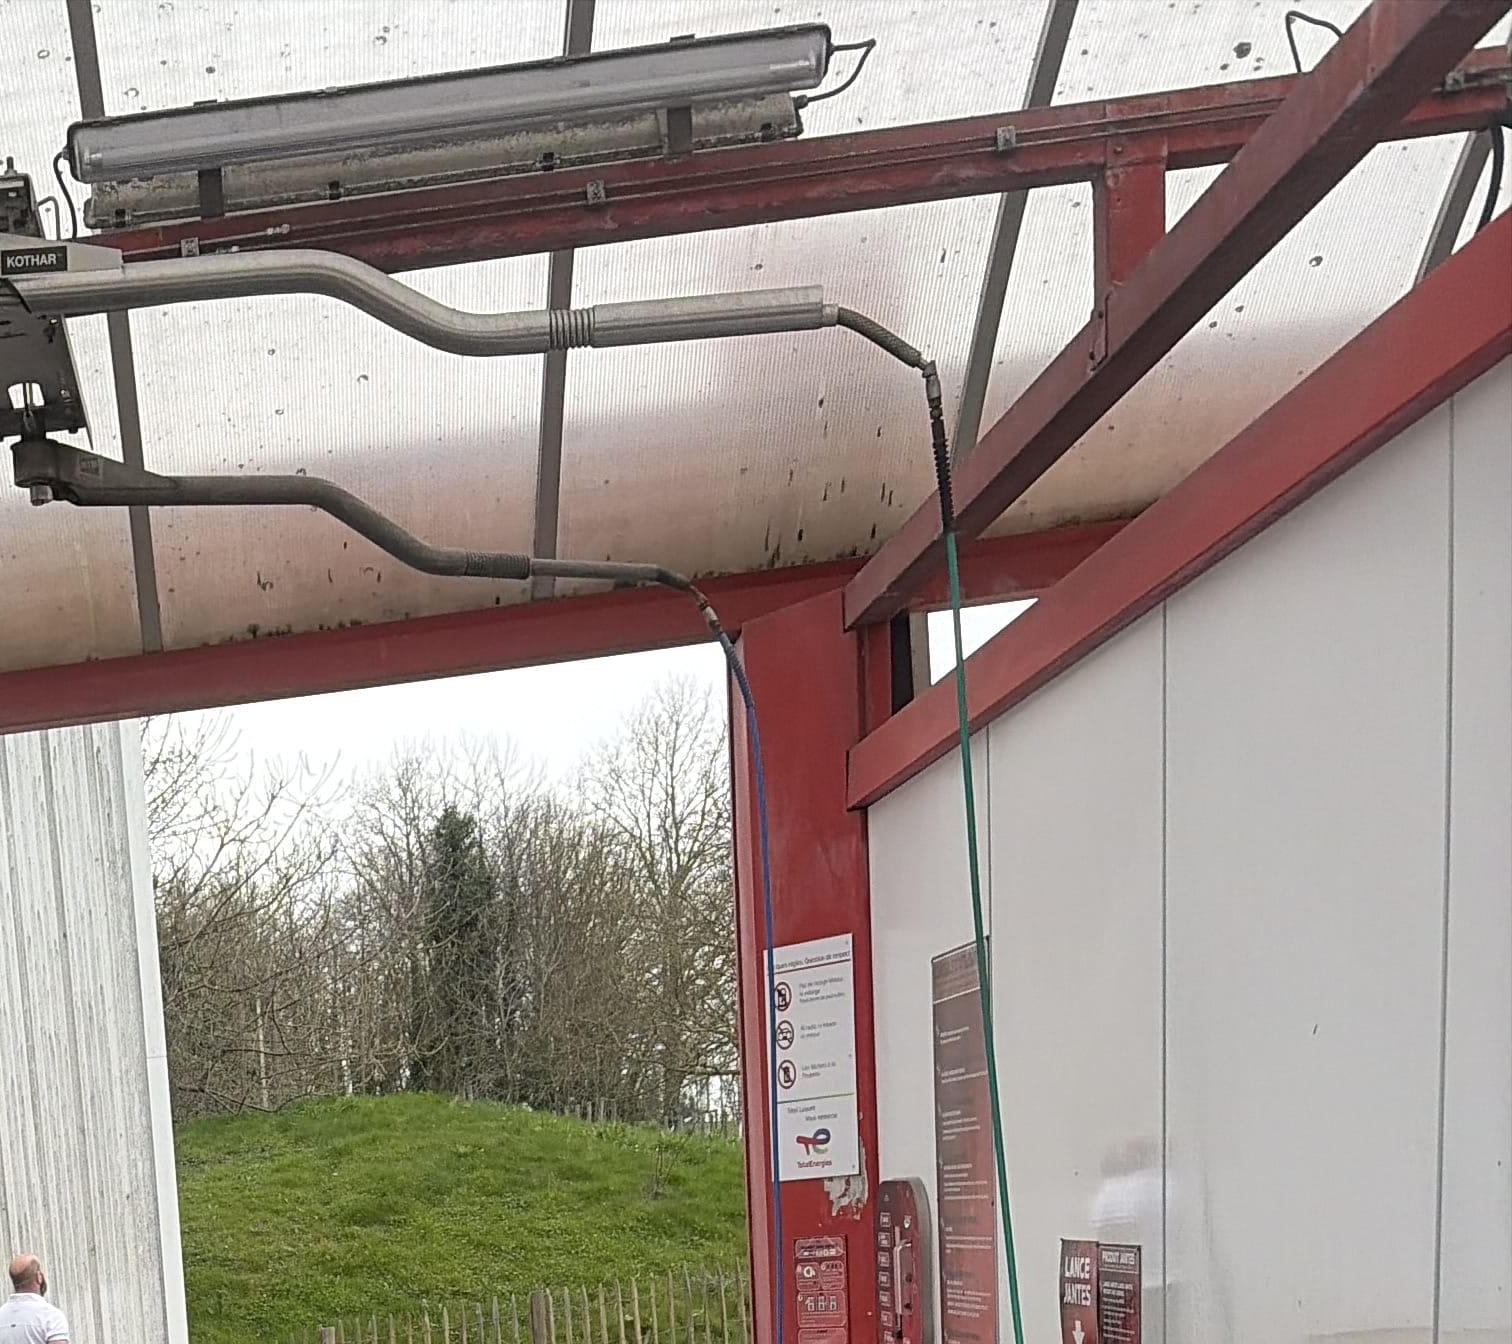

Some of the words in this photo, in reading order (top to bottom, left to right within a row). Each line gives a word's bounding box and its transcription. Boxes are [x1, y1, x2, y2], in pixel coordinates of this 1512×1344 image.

[5, 253, 57, 270] KOTHAR
[1064, 1255, 1091, 1279] LANCE
[1063, 1282, 1091, 1306] JANTES
